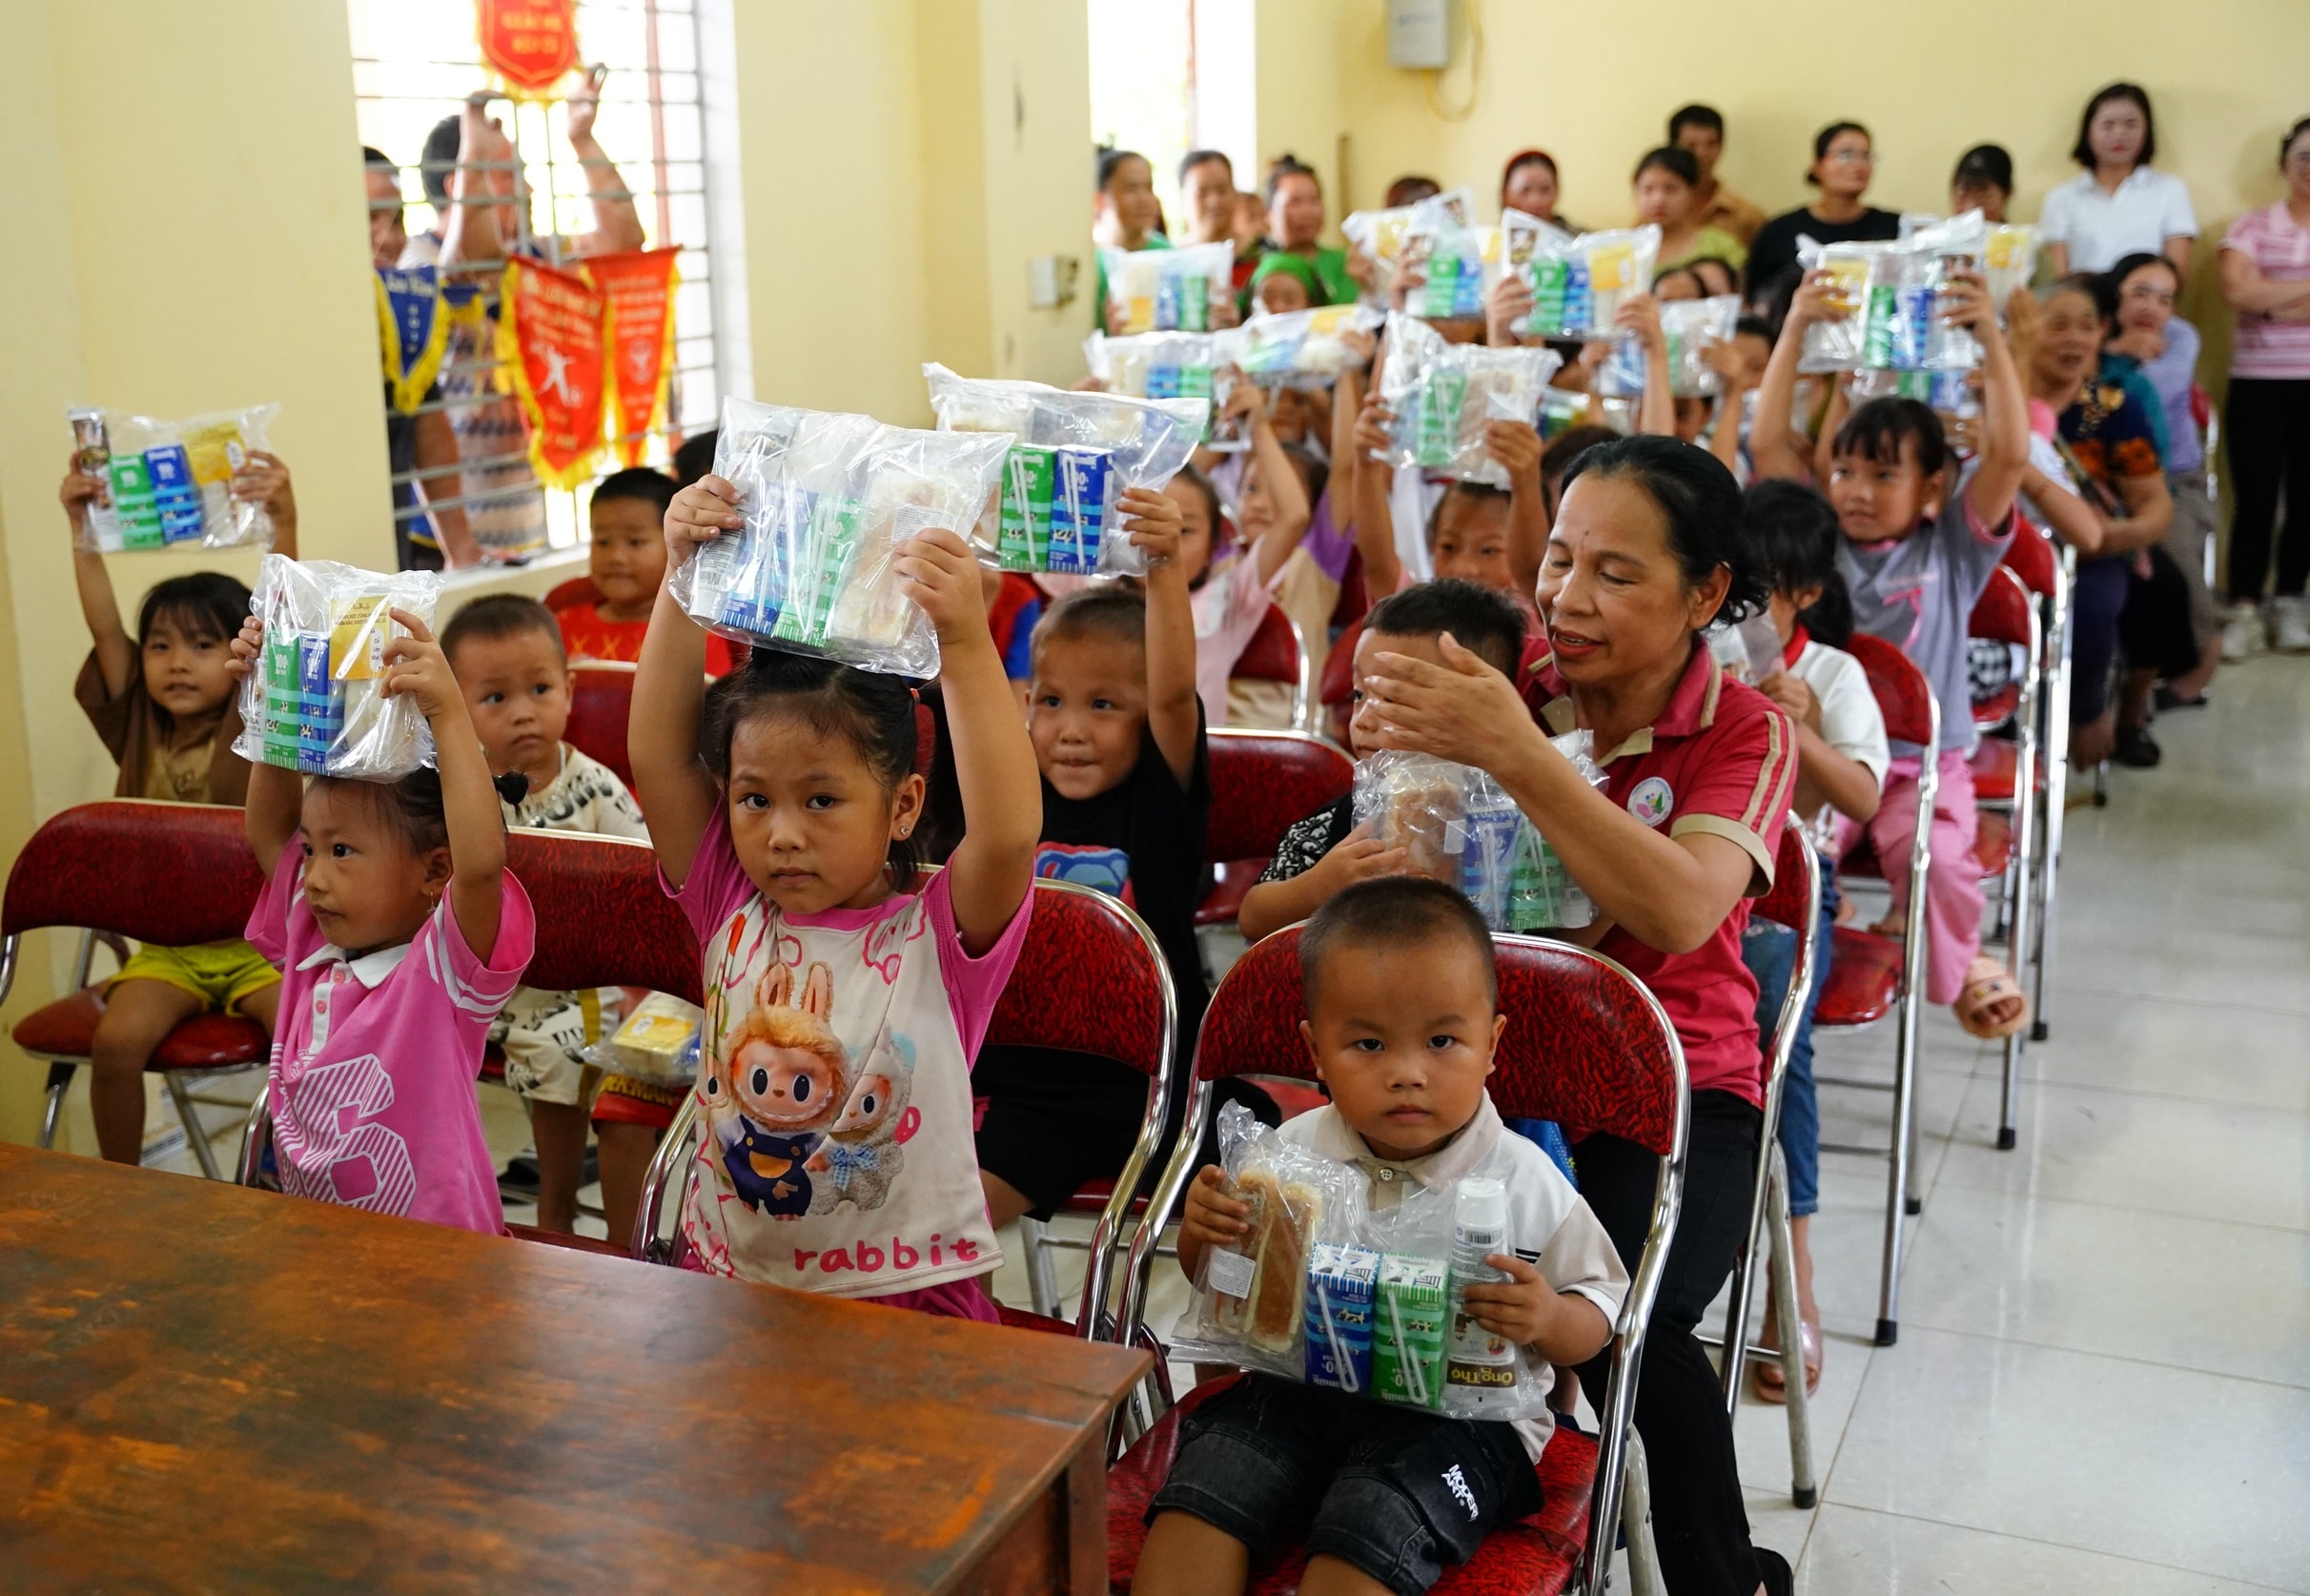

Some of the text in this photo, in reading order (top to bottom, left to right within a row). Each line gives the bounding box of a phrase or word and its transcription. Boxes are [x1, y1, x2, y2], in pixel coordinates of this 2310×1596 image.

[794, 1233, 979, 1273] rabbit
[1451, 1366, 1513, 1385] Ông Thọ
[1441, 1473, 1464, 1499] ART
